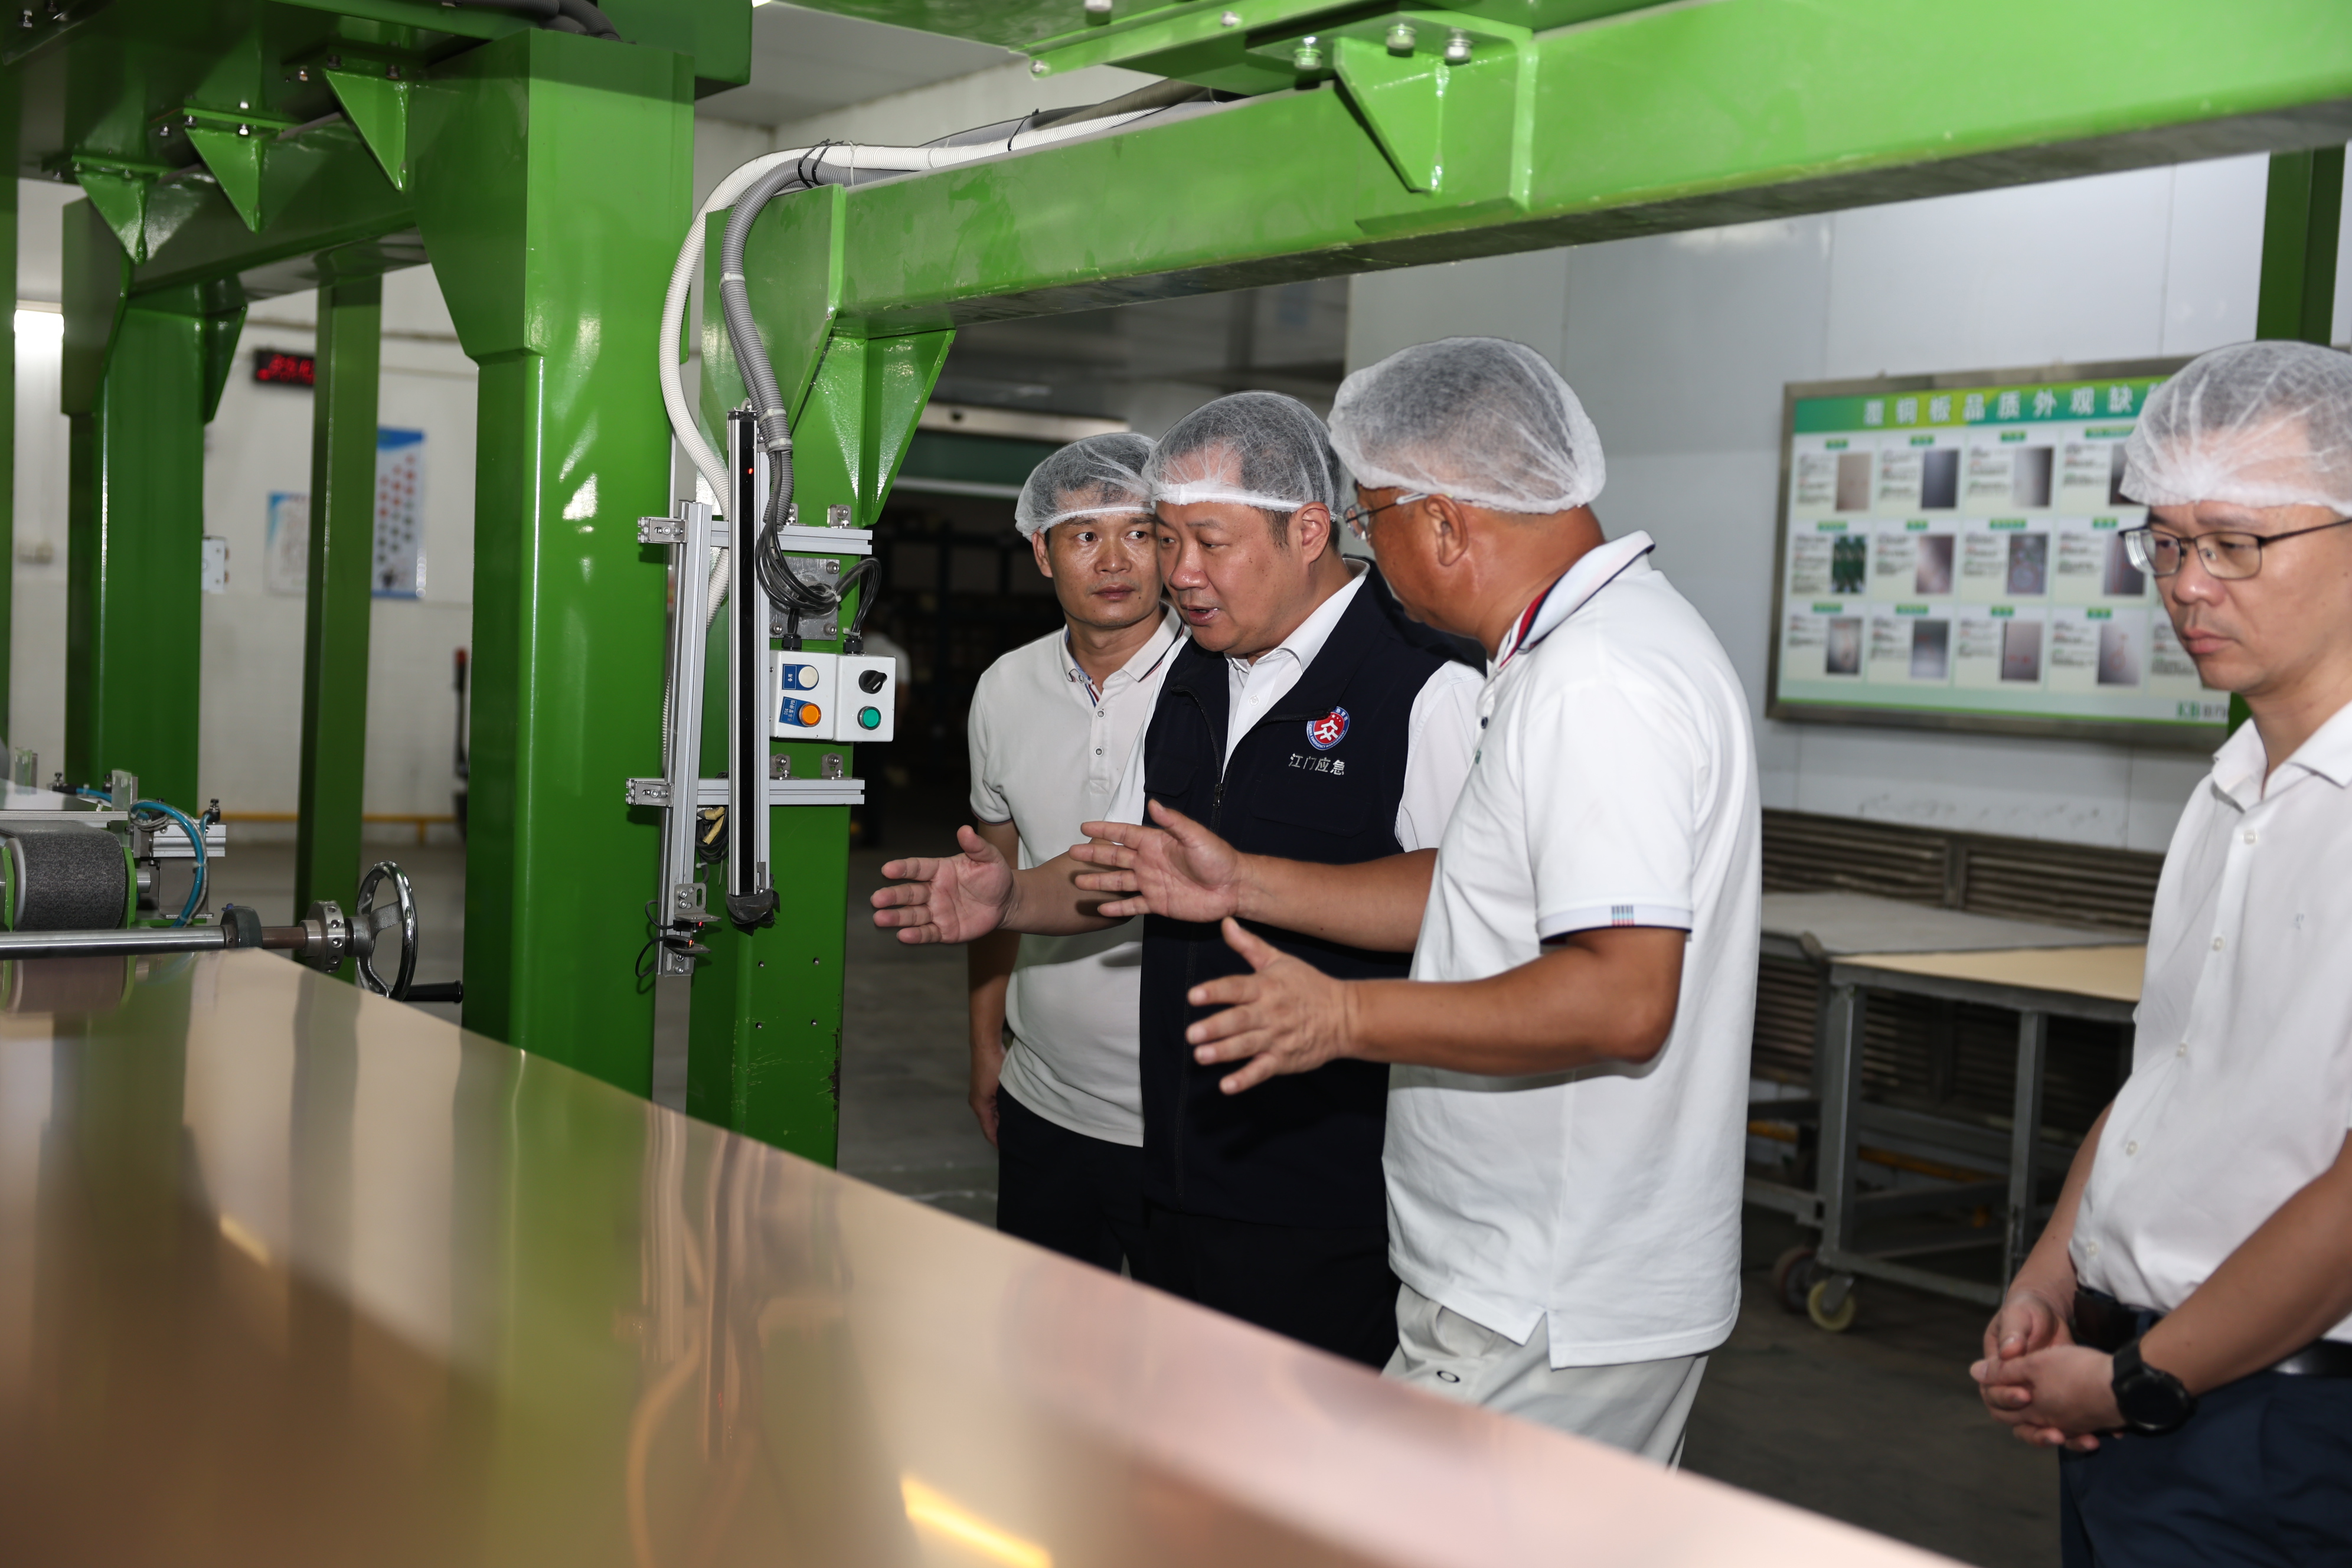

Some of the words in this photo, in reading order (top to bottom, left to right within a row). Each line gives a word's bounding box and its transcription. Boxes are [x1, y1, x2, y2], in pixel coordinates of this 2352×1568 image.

[1310, 736, 1326, 749] EMERGENCY
[1325, 730, 1346, 748] MANAGEMENT
[1288, 753, 1345, 776] 江门应急
